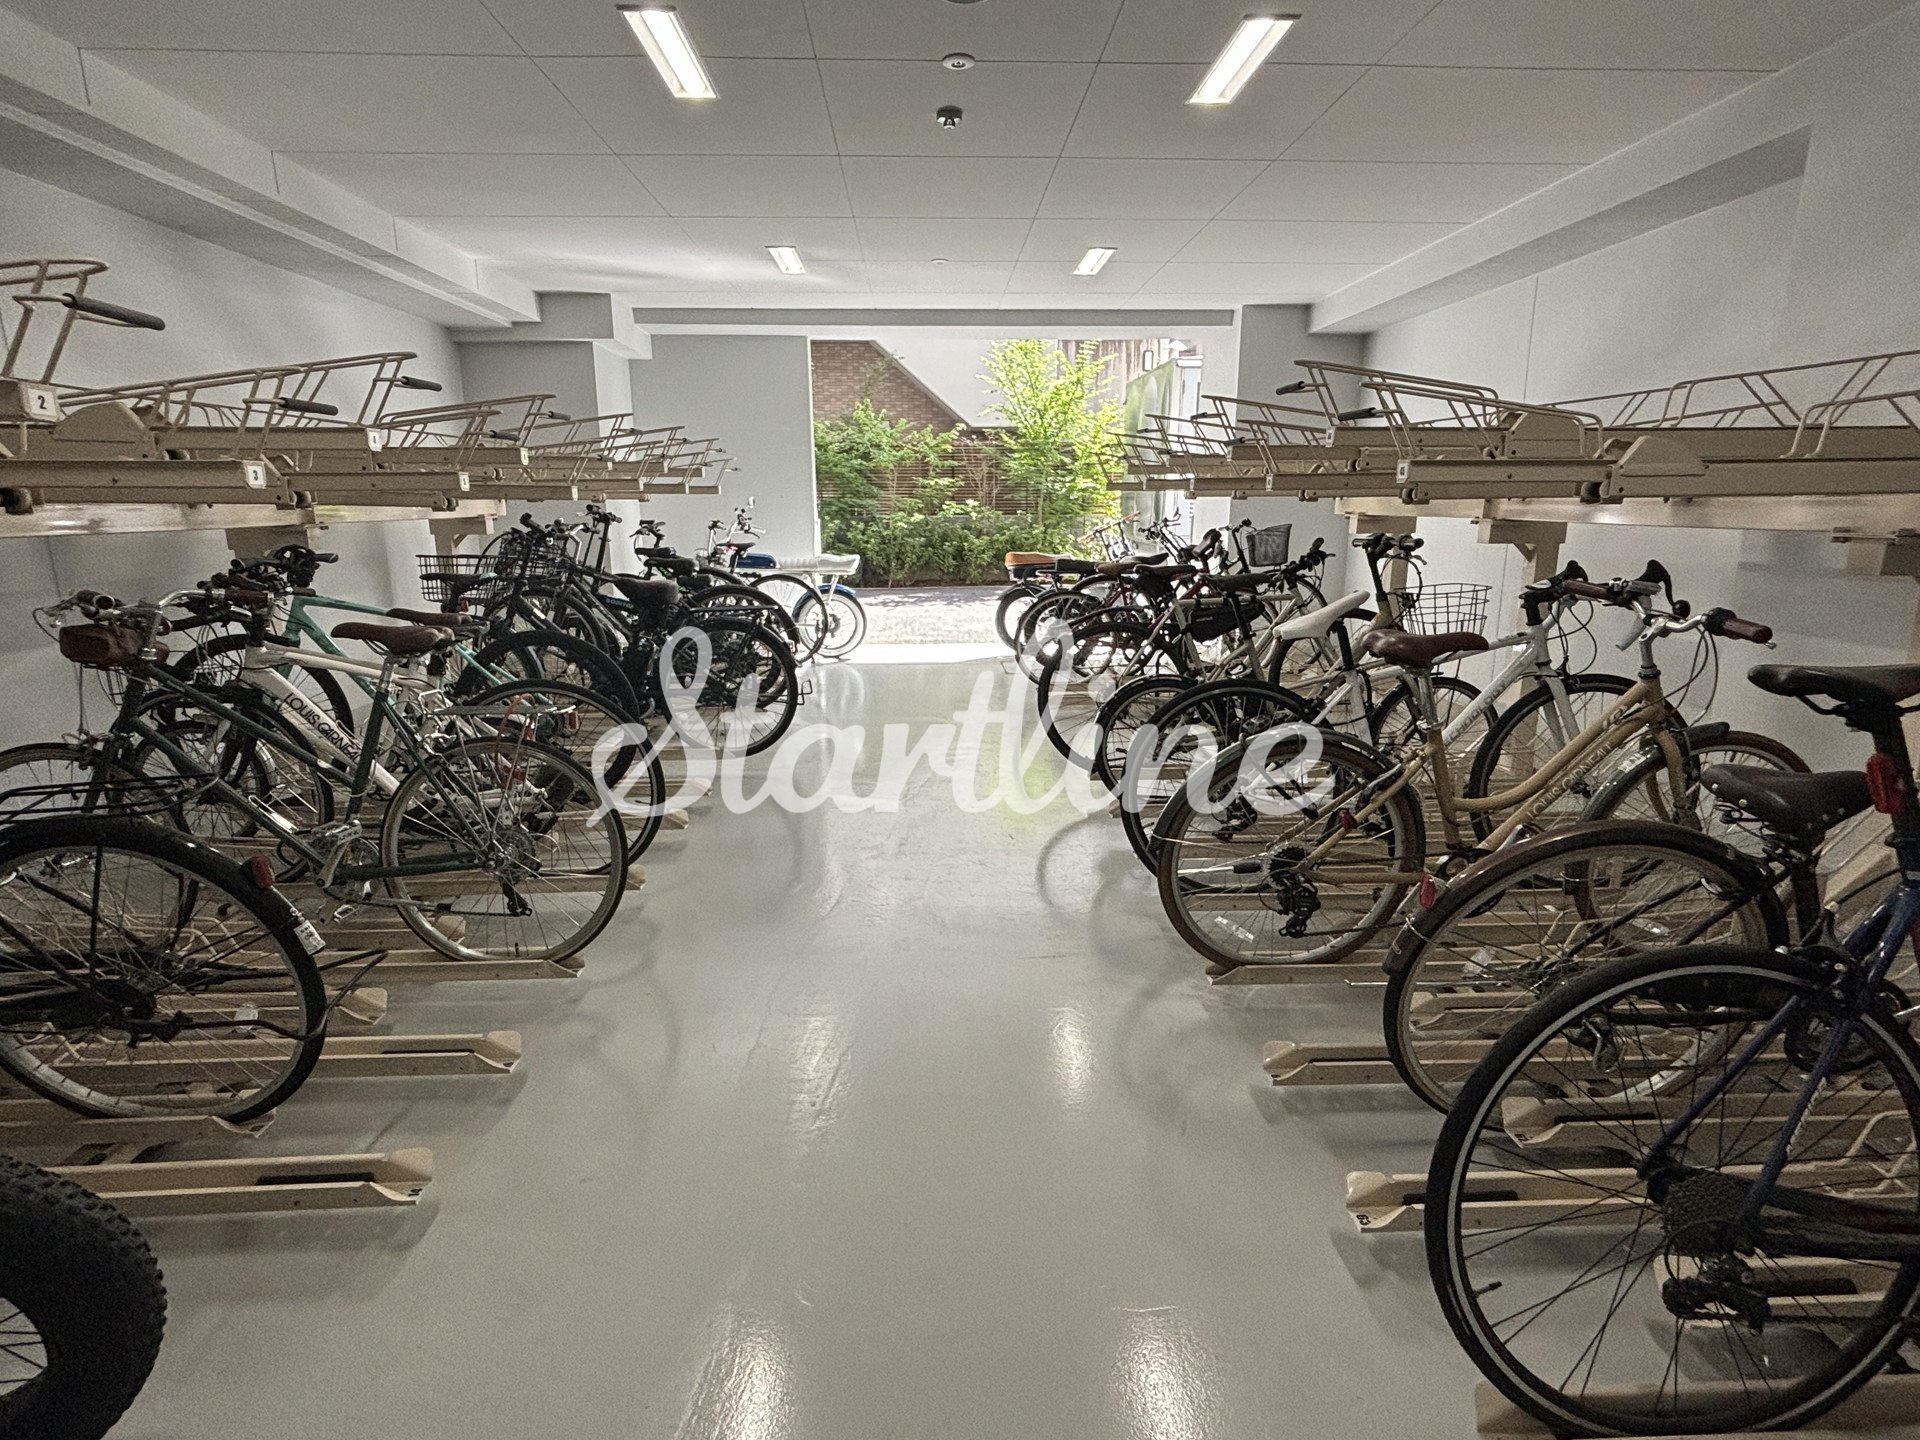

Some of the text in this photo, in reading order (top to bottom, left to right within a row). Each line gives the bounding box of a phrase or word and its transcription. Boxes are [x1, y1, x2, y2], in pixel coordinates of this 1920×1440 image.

[37, 394, 47, 410] 2
[252, 469, 259, 481] 3
[284, 692, 321, 726] LOUIS
[1356, 1214, 1371, 1226] 63
